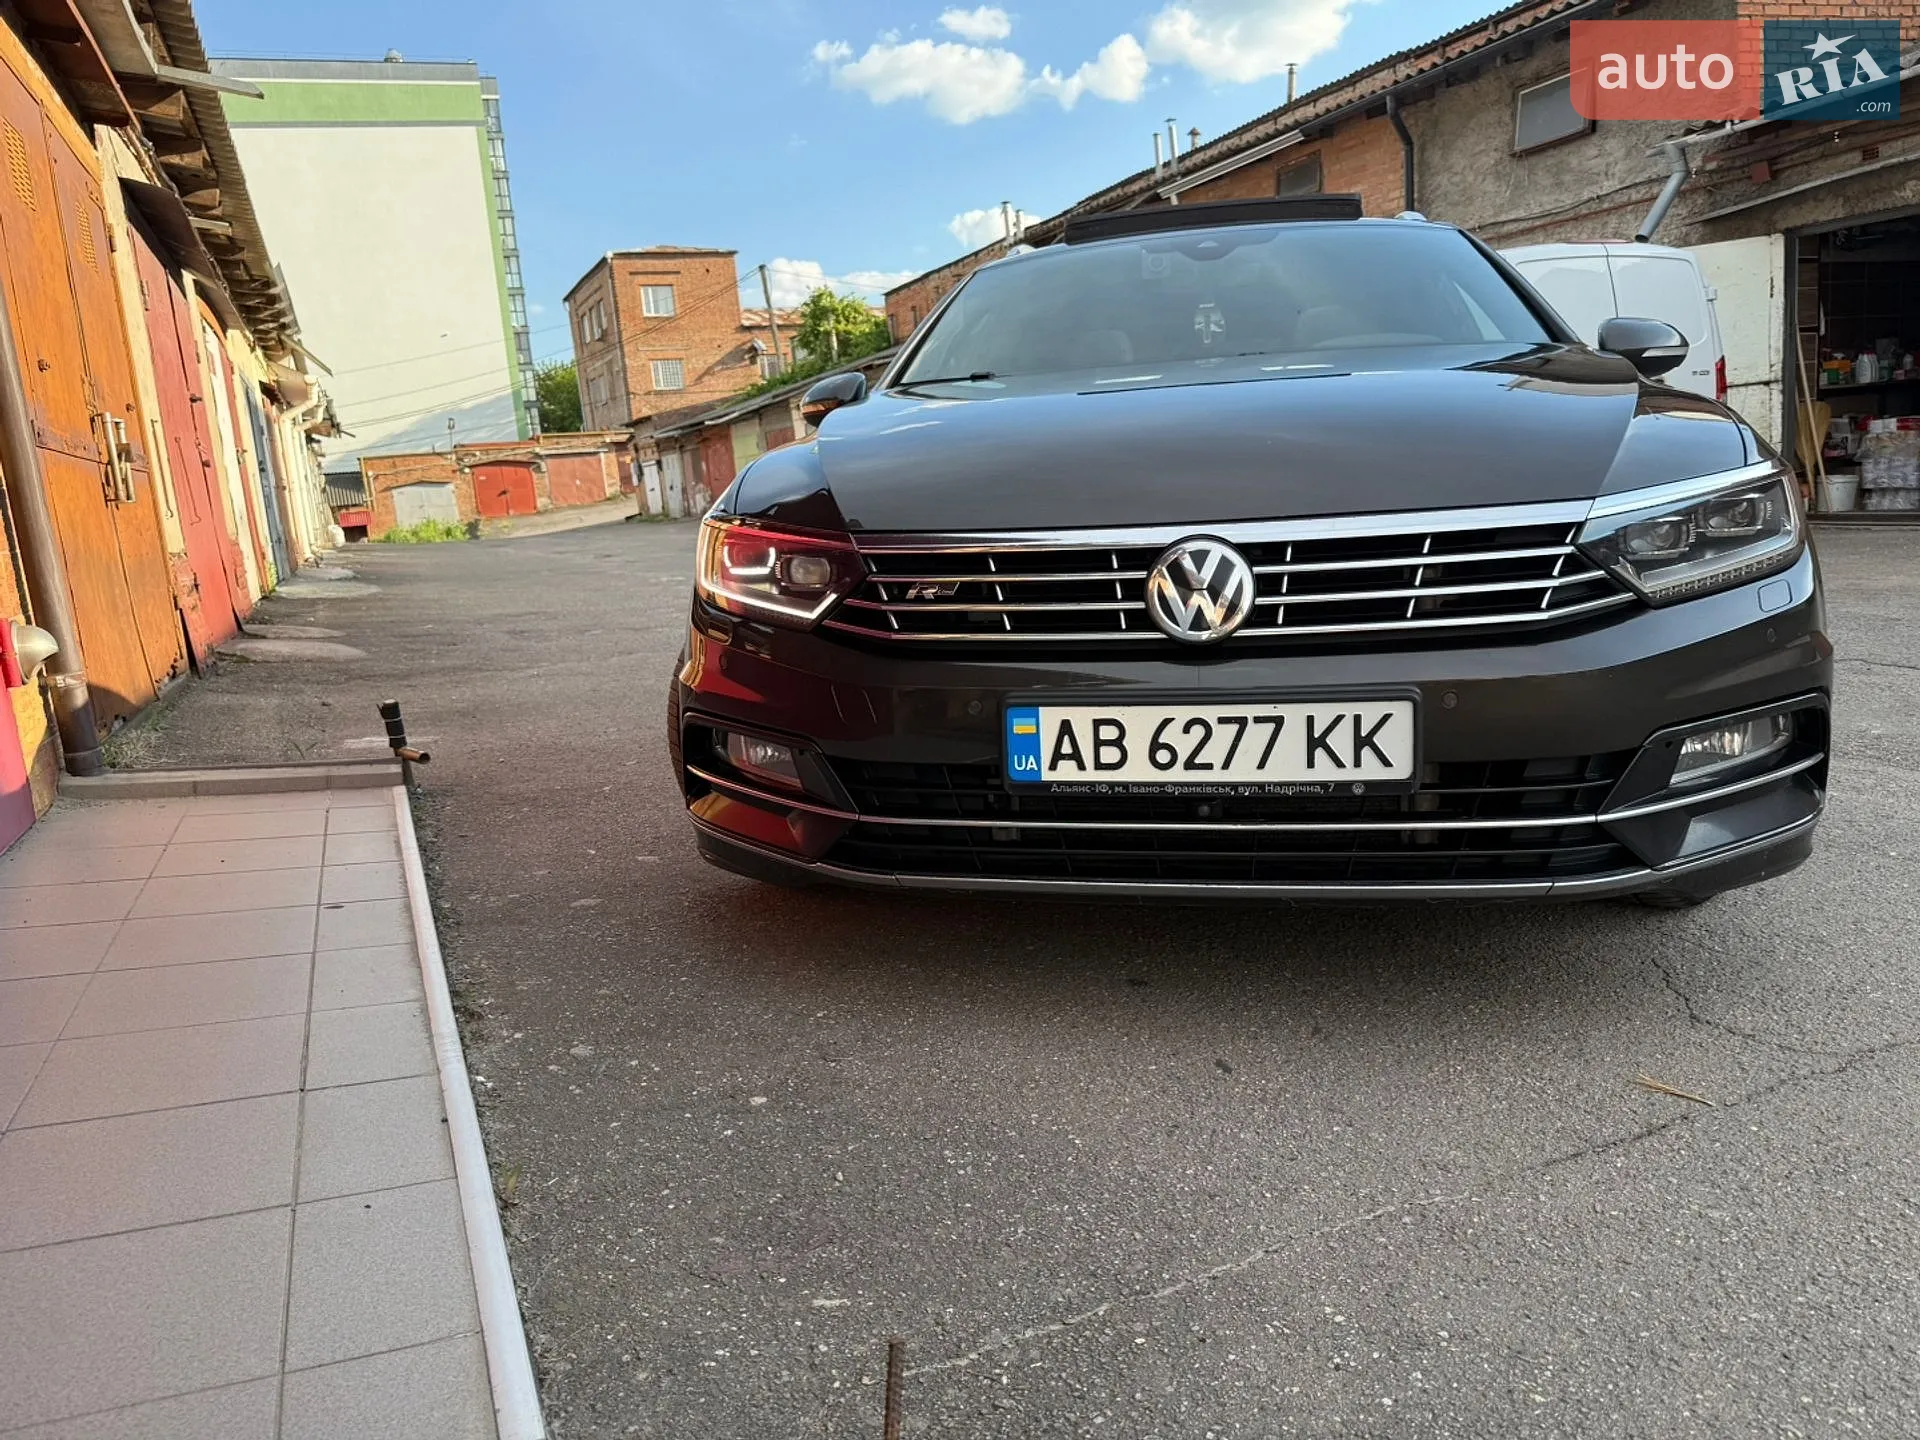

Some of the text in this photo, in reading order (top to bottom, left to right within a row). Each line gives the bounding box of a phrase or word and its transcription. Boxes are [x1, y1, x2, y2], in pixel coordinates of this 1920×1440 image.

[1047, 712, 1395, 772] AB 6277 KK
[1013, 754, 1038, 772] UA
[1238, 785, 1262, 796] вул.
[1328, 782, 1335, 793] 7
